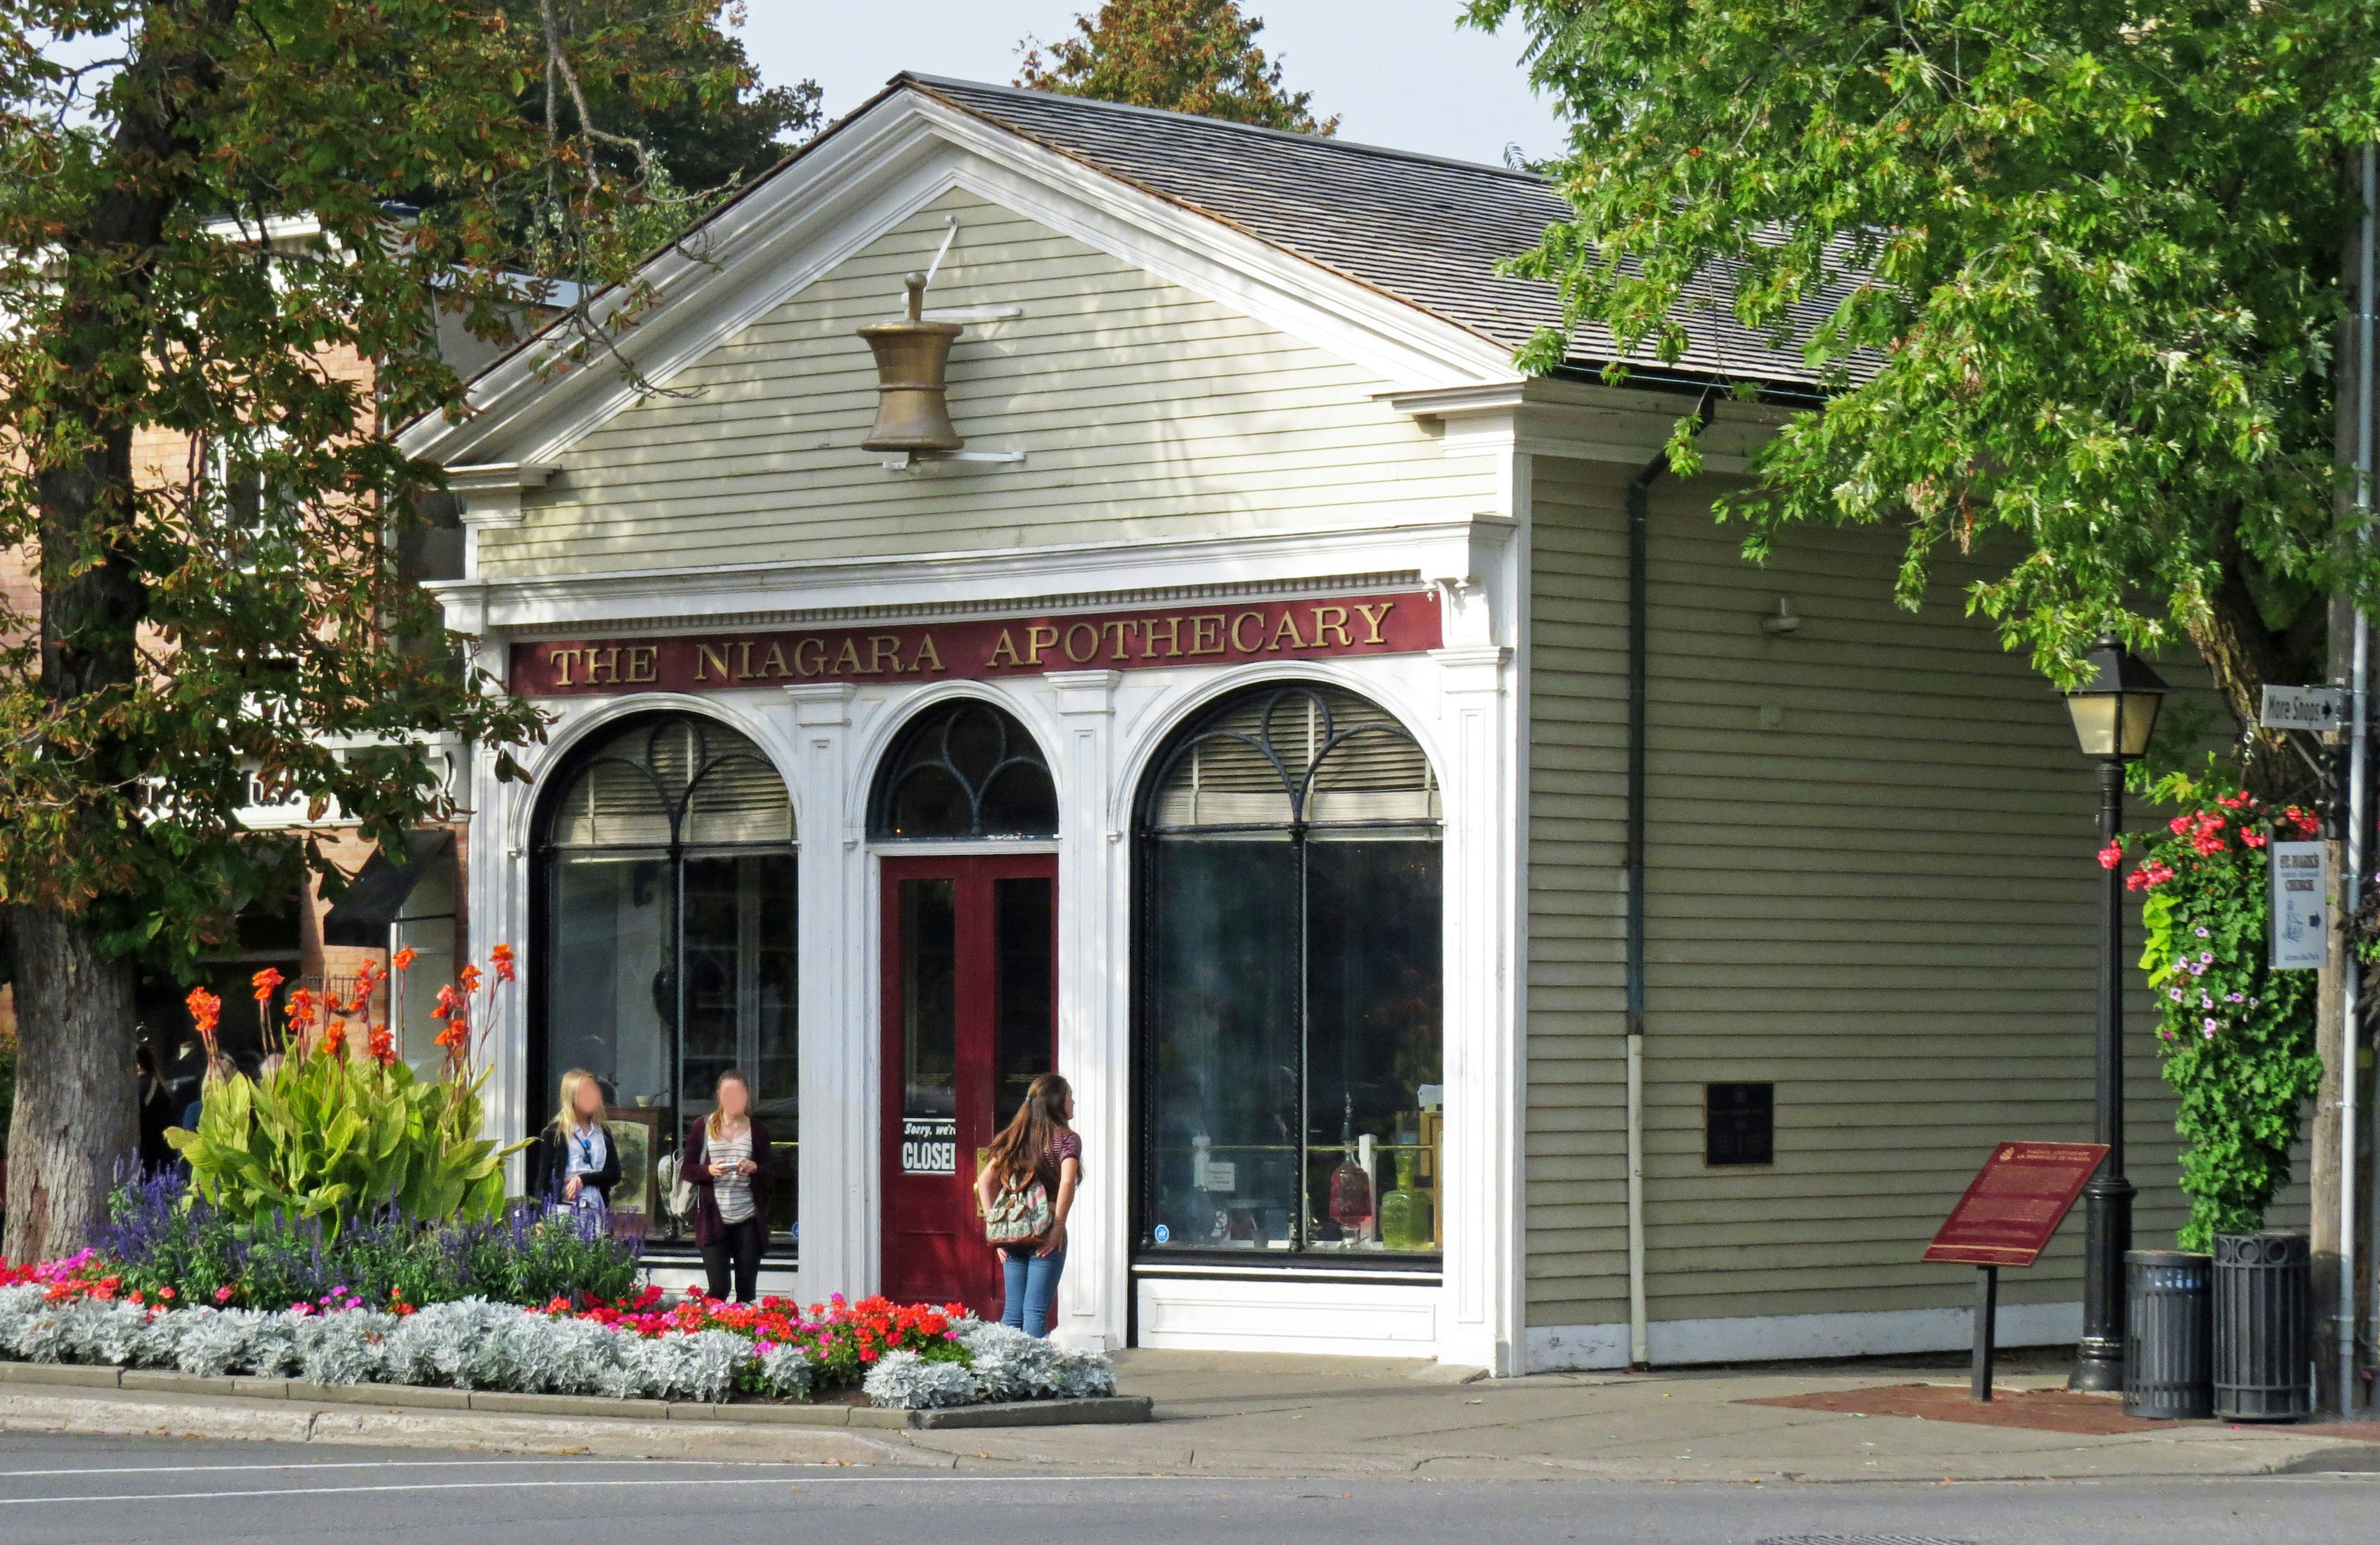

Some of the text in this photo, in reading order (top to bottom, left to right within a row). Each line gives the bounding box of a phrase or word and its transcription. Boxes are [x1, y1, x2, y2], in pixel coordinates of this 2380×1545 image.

[550, 603, 1395, 686] THE NIAGARA APOTHECARY
[904, 1123, 933, 1138] Sorry,
